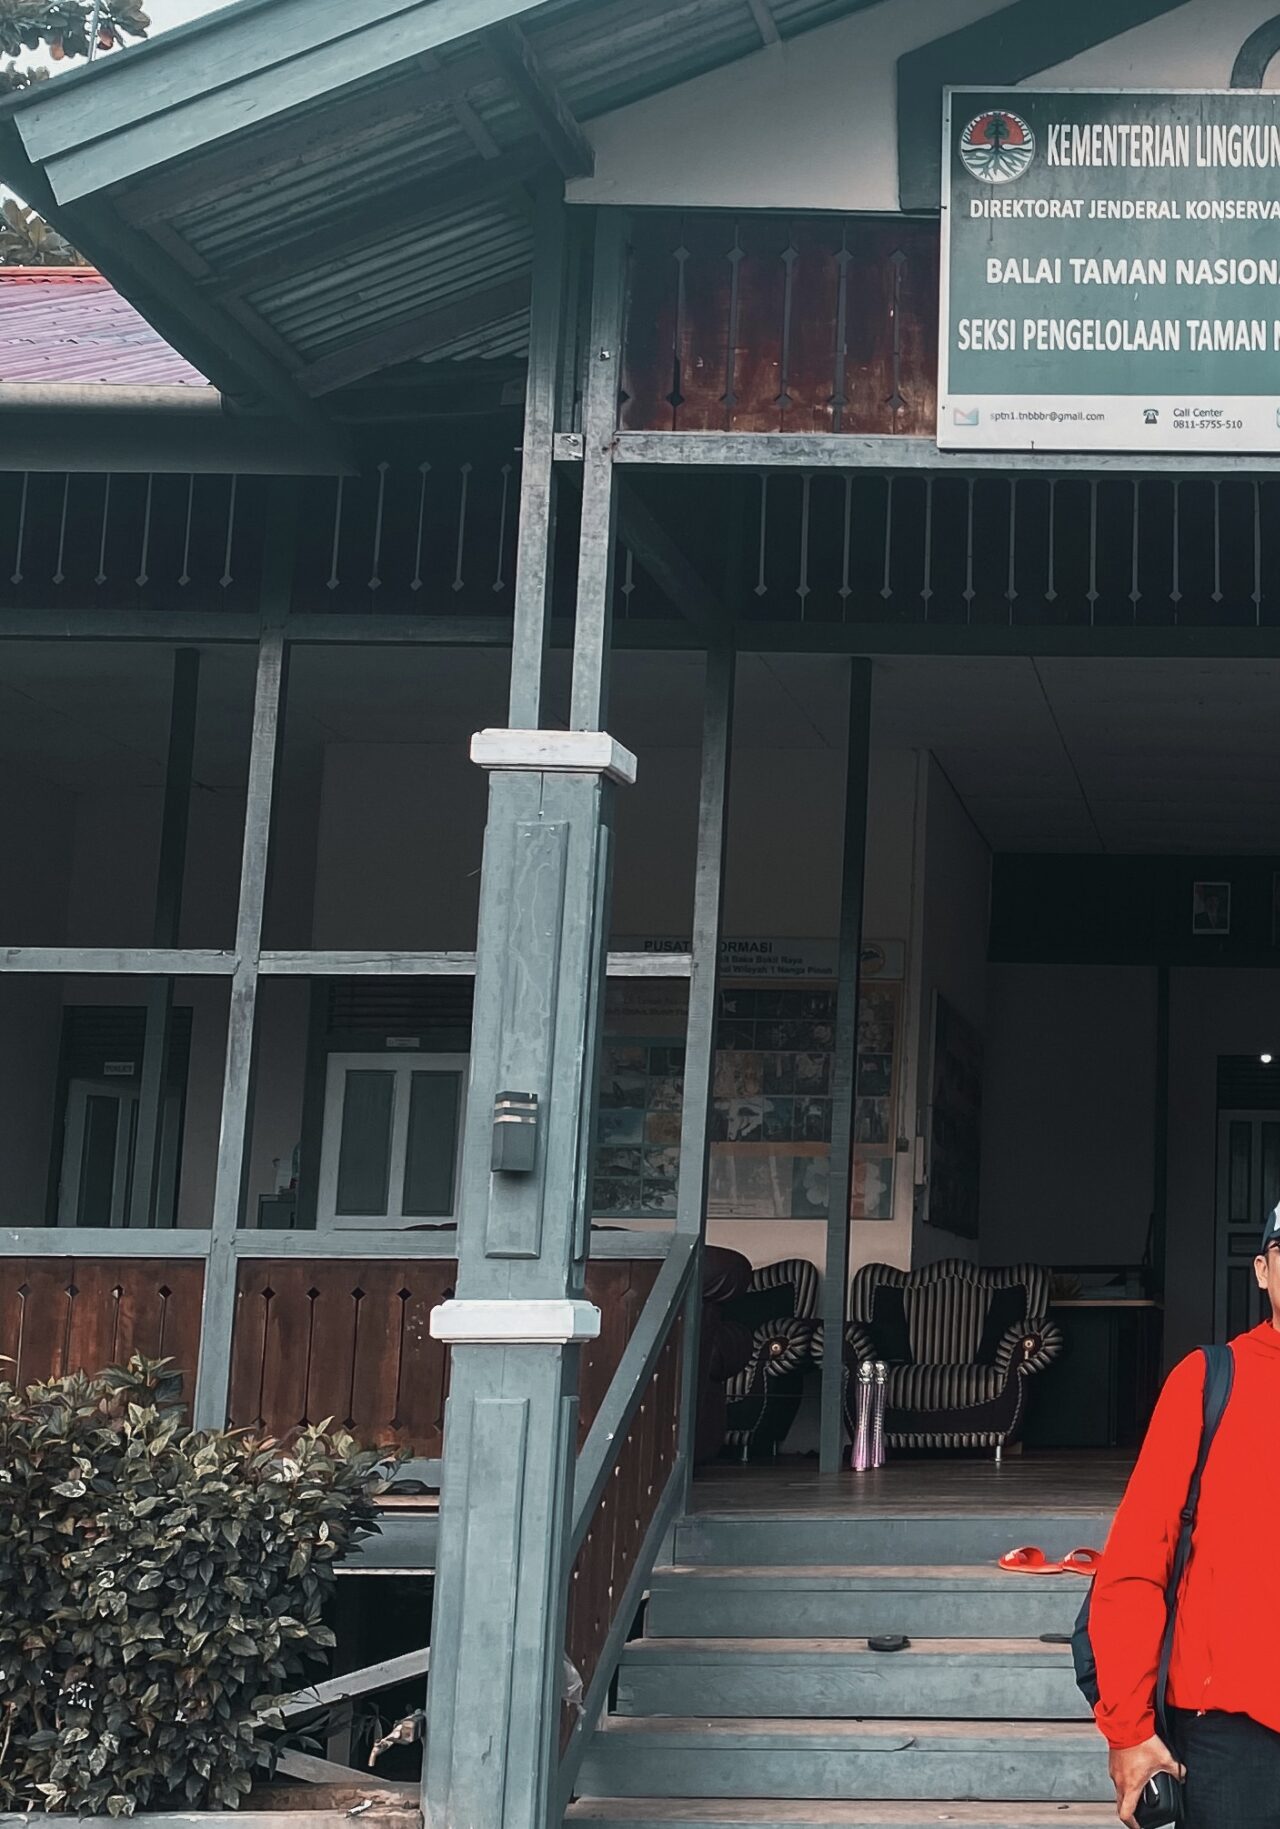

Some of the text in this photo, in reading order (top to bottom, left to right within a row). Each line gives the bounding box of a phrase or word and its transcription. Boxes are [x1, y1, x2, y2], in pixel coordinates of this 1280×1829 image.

[1047, 124, 1190, 168] KEMENTERIAN
[970, 199, 1085, 219] DIREKTORAT
[1087, 200, 1182, 220] JENDERAL
[986, 258, 1062, 284] BALAI
[1069, 258, 1167, 285] TAMAN
[957, 318, 1016, 351] SEKSI
[1023, 319, 1180, 352] PENGELOLAAN
[1186, 319, 1267, 352] TAMAN
[990, 411, 1106, 423] sptn1.tnbbbr@gmail.com
[1173, 408, 1224, 418] Call Center
[1173, 419, 1243, 429] 0811-5755-510
[644, 940, 691, 952] PUSAT
